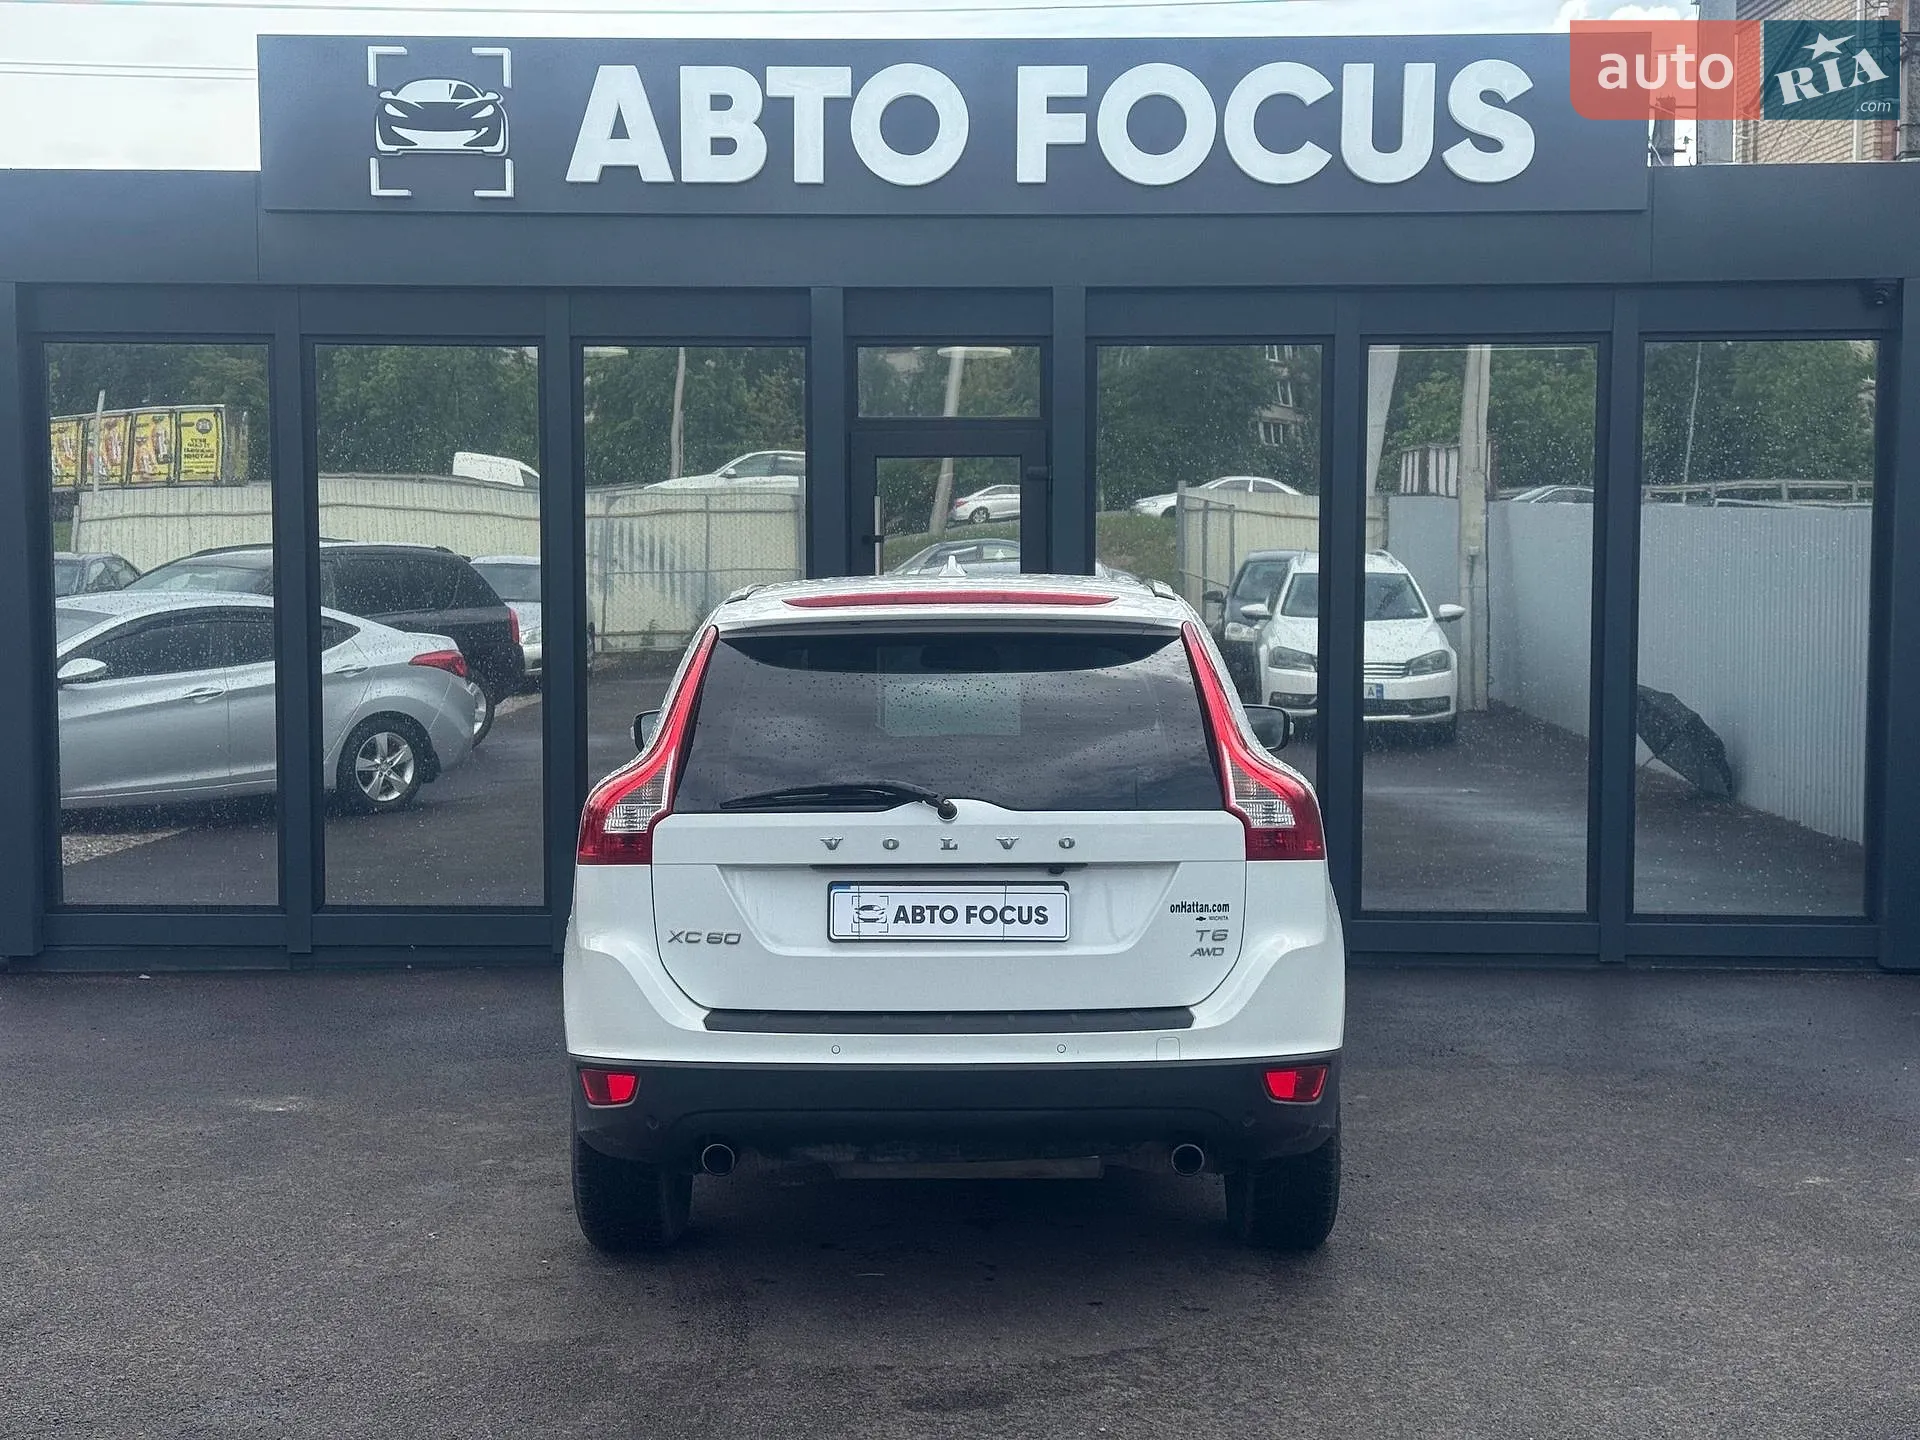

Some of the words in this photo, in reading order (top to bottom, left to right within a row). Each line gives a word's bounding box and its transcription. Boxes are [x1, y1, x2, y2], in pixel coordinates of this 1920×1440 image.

[565, 62, 970, 186] АВТО
[1016, 58, 1536, 186] FOCUS
[819, 836, 1076, 851] VOLVO
[1169, 900, 1230, 914] onHattan.com
[893, 905, 959, 925] АВТО
[965, 905, 1050, 926] FOCUS
[1195, 929, 1230, 942] T6
[1189, 946, 1225, 958] AWD
